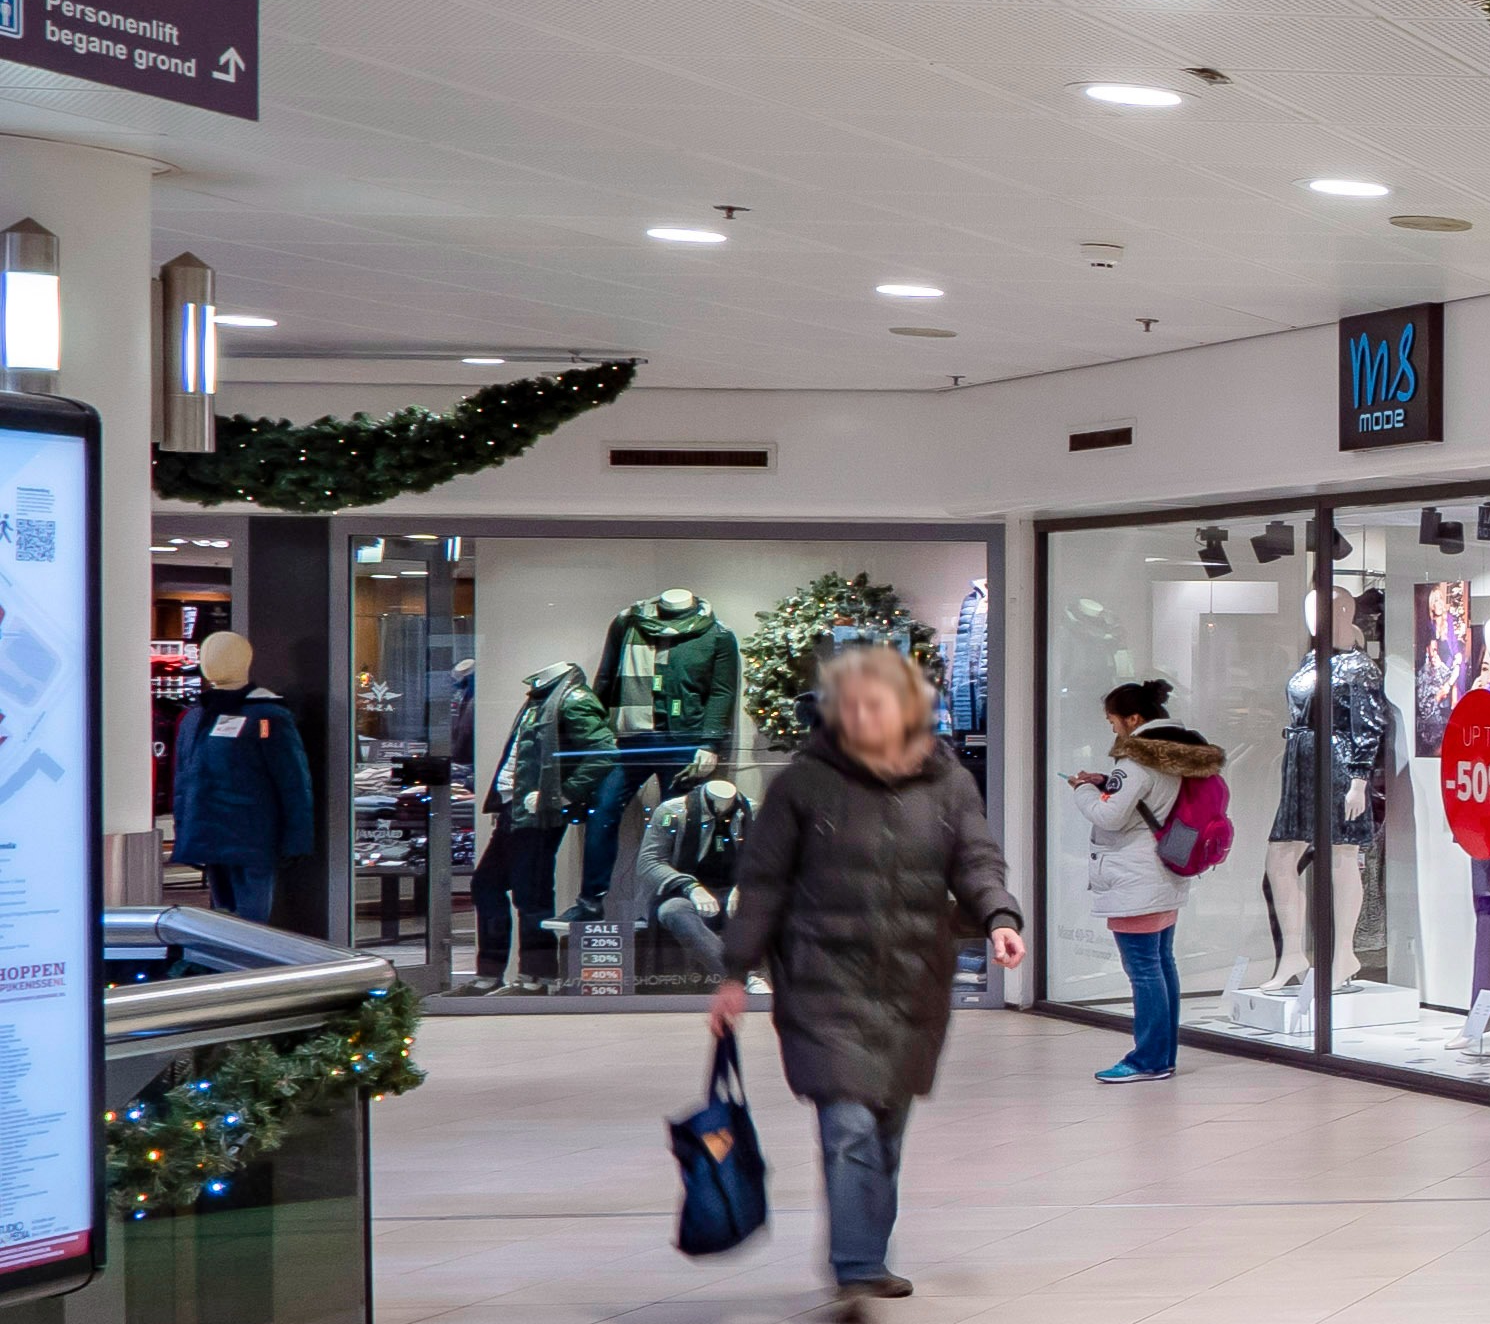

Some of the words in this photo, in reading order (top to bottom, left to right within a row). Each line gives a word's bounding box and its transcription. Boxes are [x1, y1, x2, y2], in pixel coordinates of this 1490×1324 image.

[45, 19, 127, 59] begane
[134, 47, 196, 78] grond
[1462, 725, 1481, 747] UP
[585, 925, 619, 934] SALE
